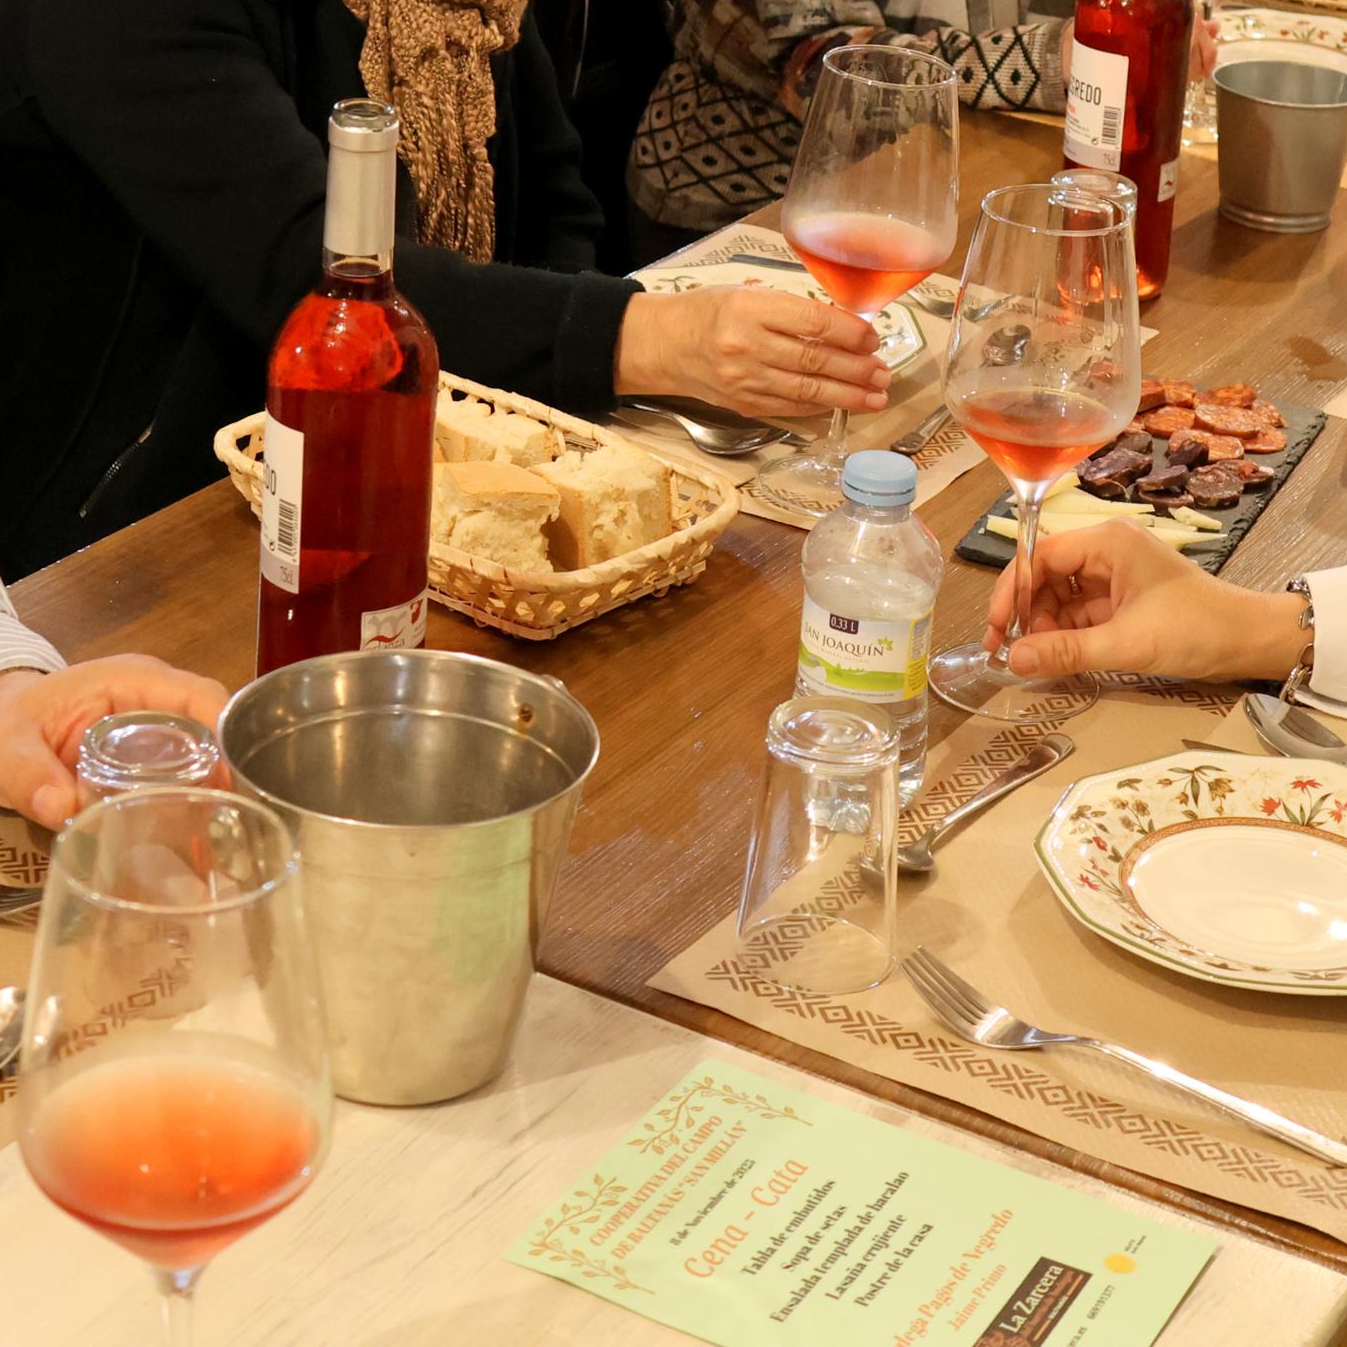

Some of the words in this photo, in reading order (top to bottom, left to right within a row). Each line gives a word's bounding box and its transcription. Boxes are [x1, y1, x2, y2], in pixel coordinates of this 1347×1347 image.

[822, 635, 885, 658] JOAQUÍN
[589, 1174, 668, 1246] COOPERATIVA
[660, 1153, 688, 1176] DEL
[682, 1115, 723, 1154] CAMPO
[677, 1228, 690, 1240] de
[723, 1177, 737, 1190] de
[866, 1171, 910, 1212] bacalao
[611, 1240, 635, 1260] DE
[627, 1187, 685, 1244] BALTANÁS
[683, 1224, 749, 1278] Cena
[751, 1159, 809, 1207] Cata
[740, 1246, 777, 1275] Tabla
[770, 1232, 788, 1247] de
[785, 1180, 837, 1233] embutidos
[781, 1245, 812, 1272] Sopa
[805, 1230, 823, 1246] de
[821, 1205, 847, 1231] setas
[814, 1224, 865, 1274] templada
[857, 1210, 876, 1226] de
[909, 1223, 934, 1247] casa
[825, 1261, 867, 1300] Lasaña
[863, 1214, 907, 1263] crujiente
[885, 1256, 904, 1273] de
[894, 1245, 915, 1258] la
[918, 1279, 957, 1318] Pagos
[950, 1262, 971, 1281] de
[962, 1208, 1013, 1260] Negredo
[769, 1273, 822, 1322] Ensalada
[853, 1271, 892, 1307] Postre
[948, 1298, 980, 1331] Jaime
[972, 1263, 1007, 1298] Primo
[999, 1315, 1027, 1334] La
[1013, 1265, 1064, 1315] Zarcera
